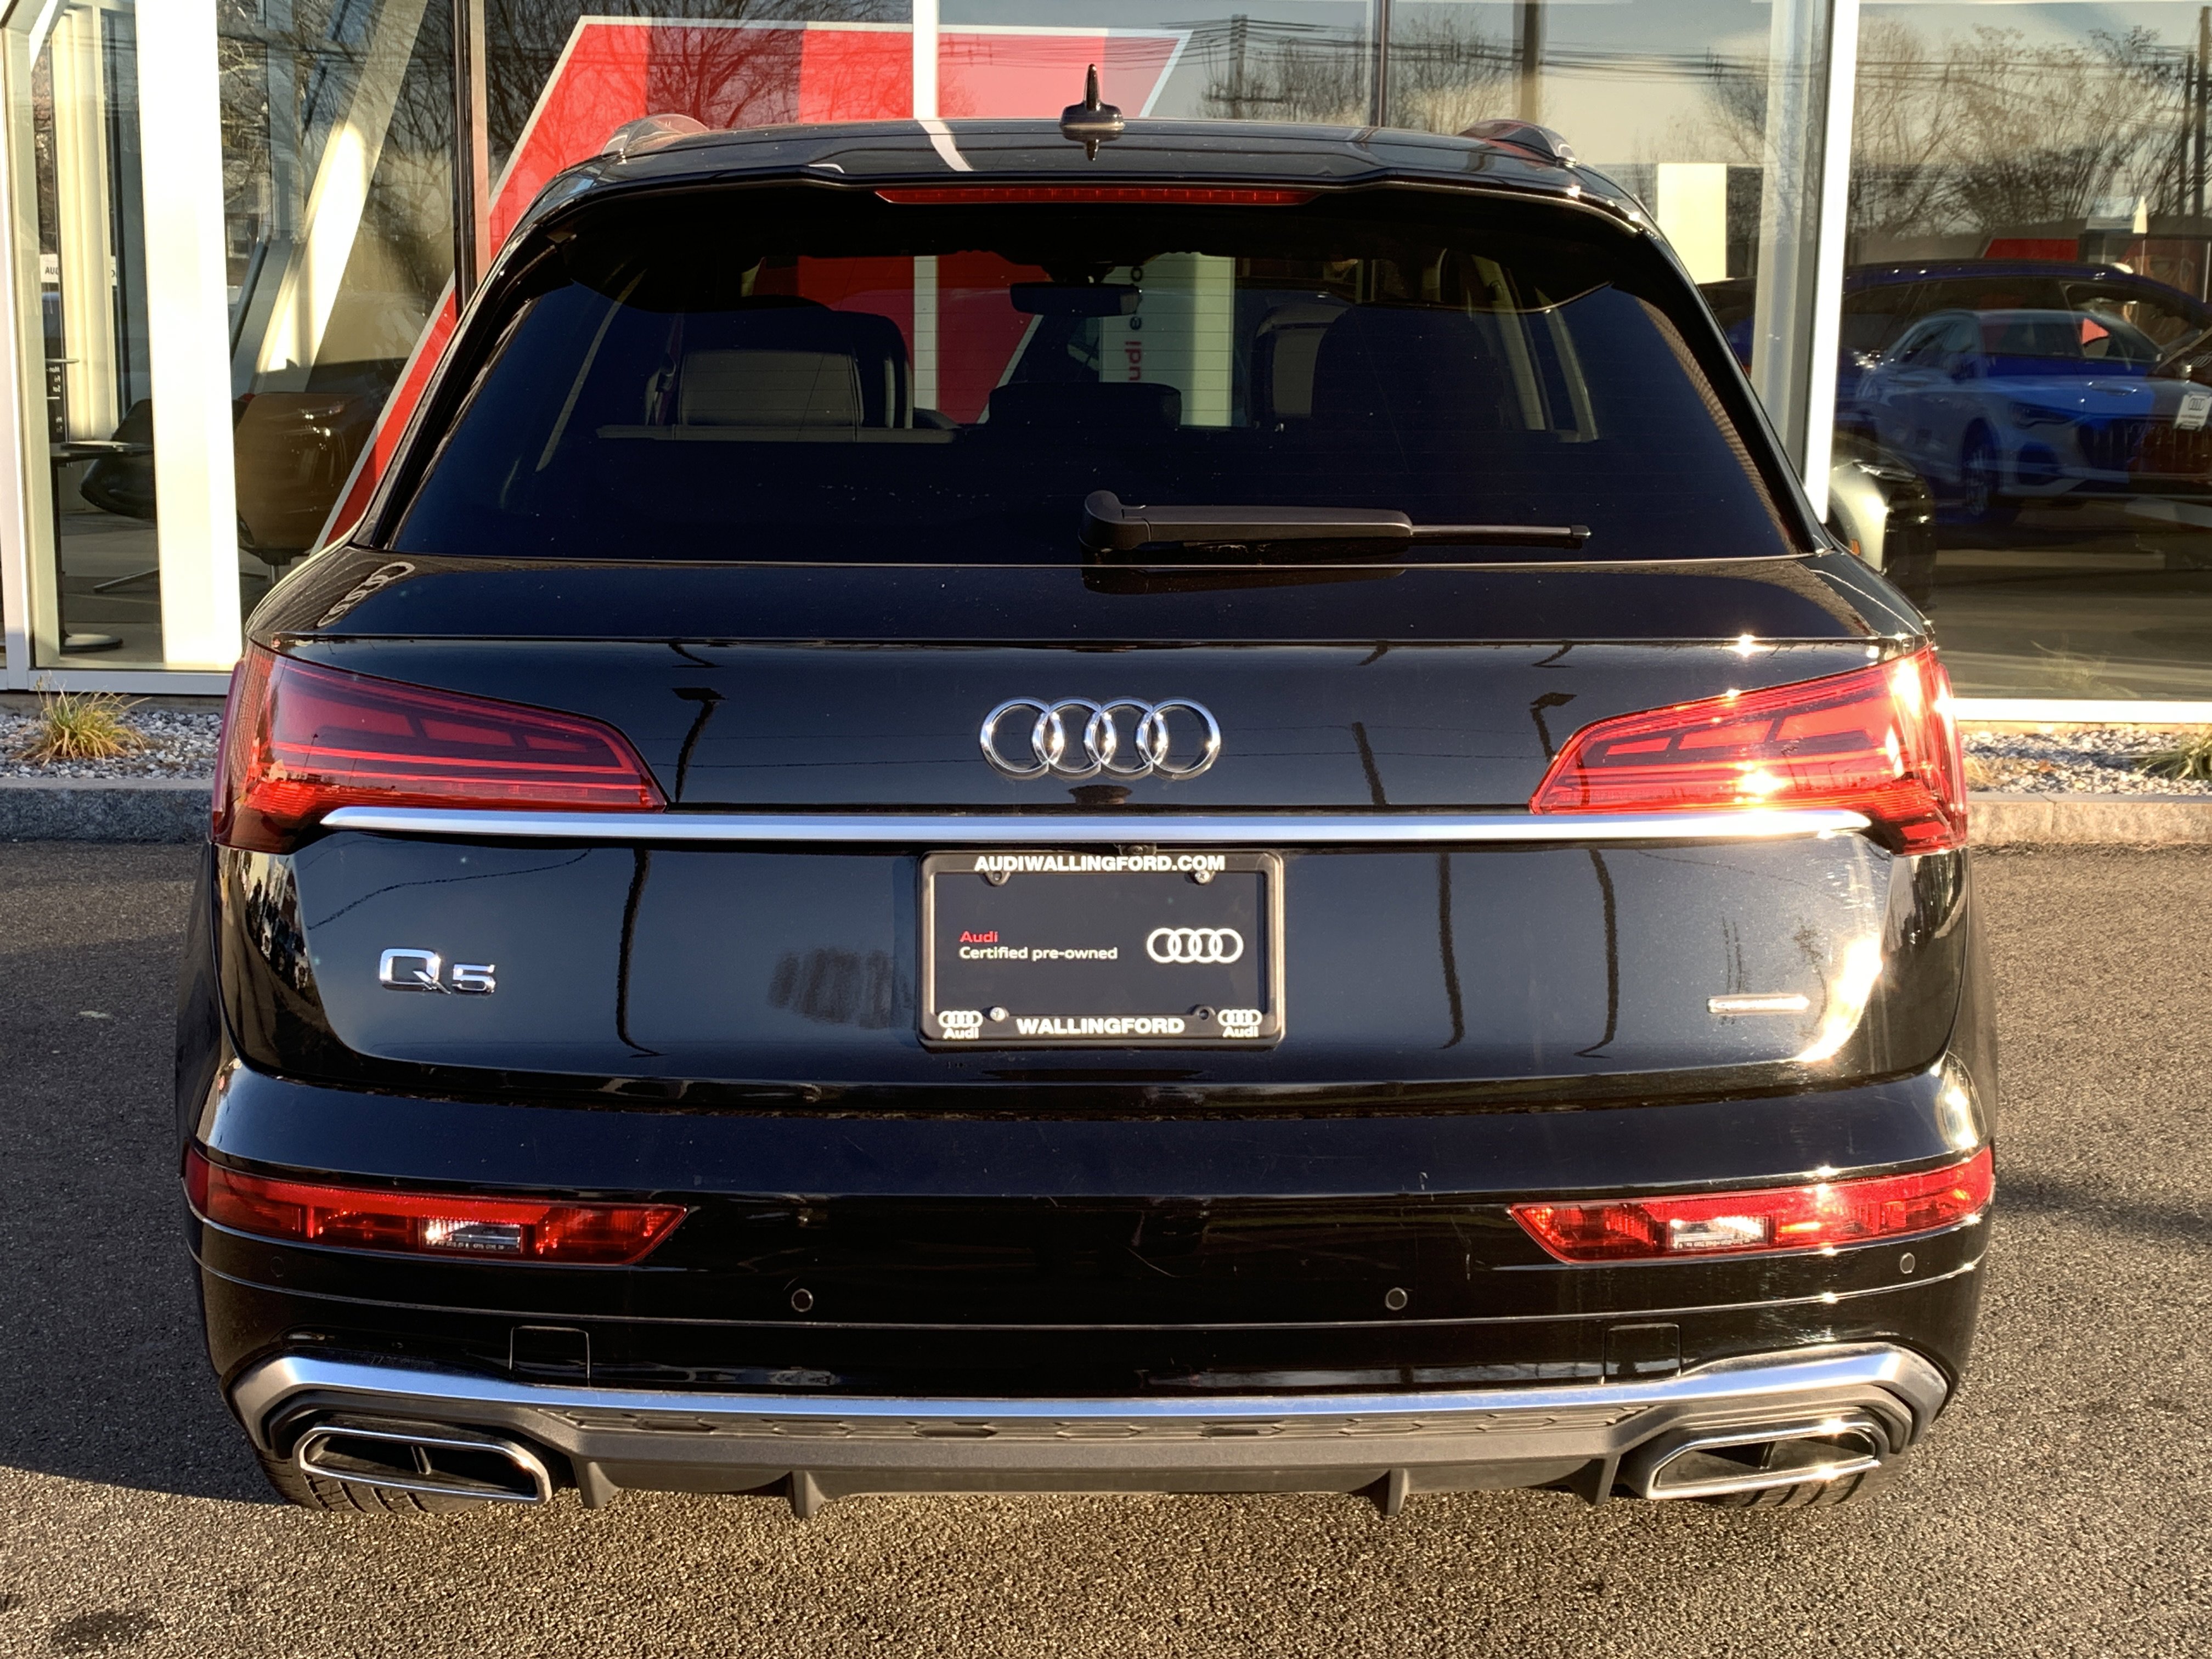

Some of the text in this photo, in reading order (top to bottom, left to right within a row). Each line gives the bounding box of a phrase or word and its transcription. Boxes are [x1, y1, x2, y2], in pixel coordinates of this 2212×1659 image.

[1125, 341, 1142, 381] udi
[974, 855, 1226, 871] AUDIWALLINGFORD.COM
[960, 931, 998, 943] Audi
[960, 946, 1118, 961] Certified pre-owned
[379, 948, 495, 994] Q5
[943, 1027, 979, 1039] Audi
[1017, 1018, 1185, 1034] WALLINGFORD
[1223, 1026, 1259, 1037] Audi
